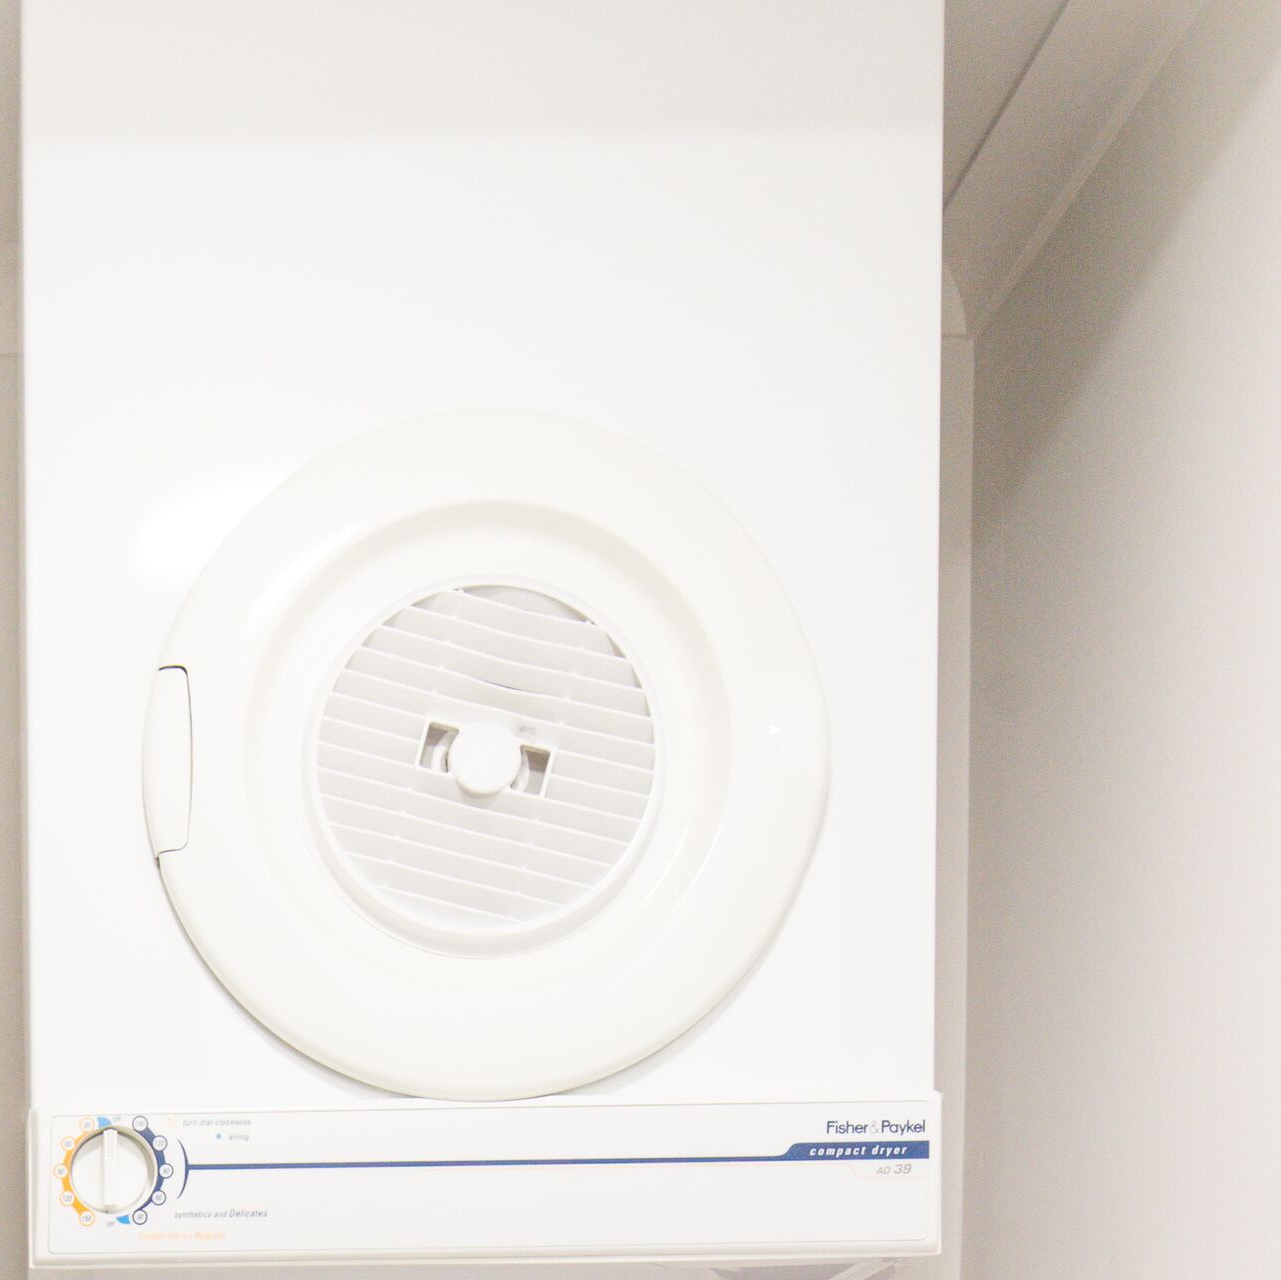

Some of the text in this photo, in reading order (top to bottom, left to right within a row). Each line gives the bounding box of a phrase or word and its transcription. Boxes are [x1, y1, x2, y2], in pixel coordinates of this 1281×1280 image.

[810, 1144, 907, 1158] compact dryer
[894, 1163, 912, 1175] 39
[174, 1209, 268, 1219] synthetics and Delicates
